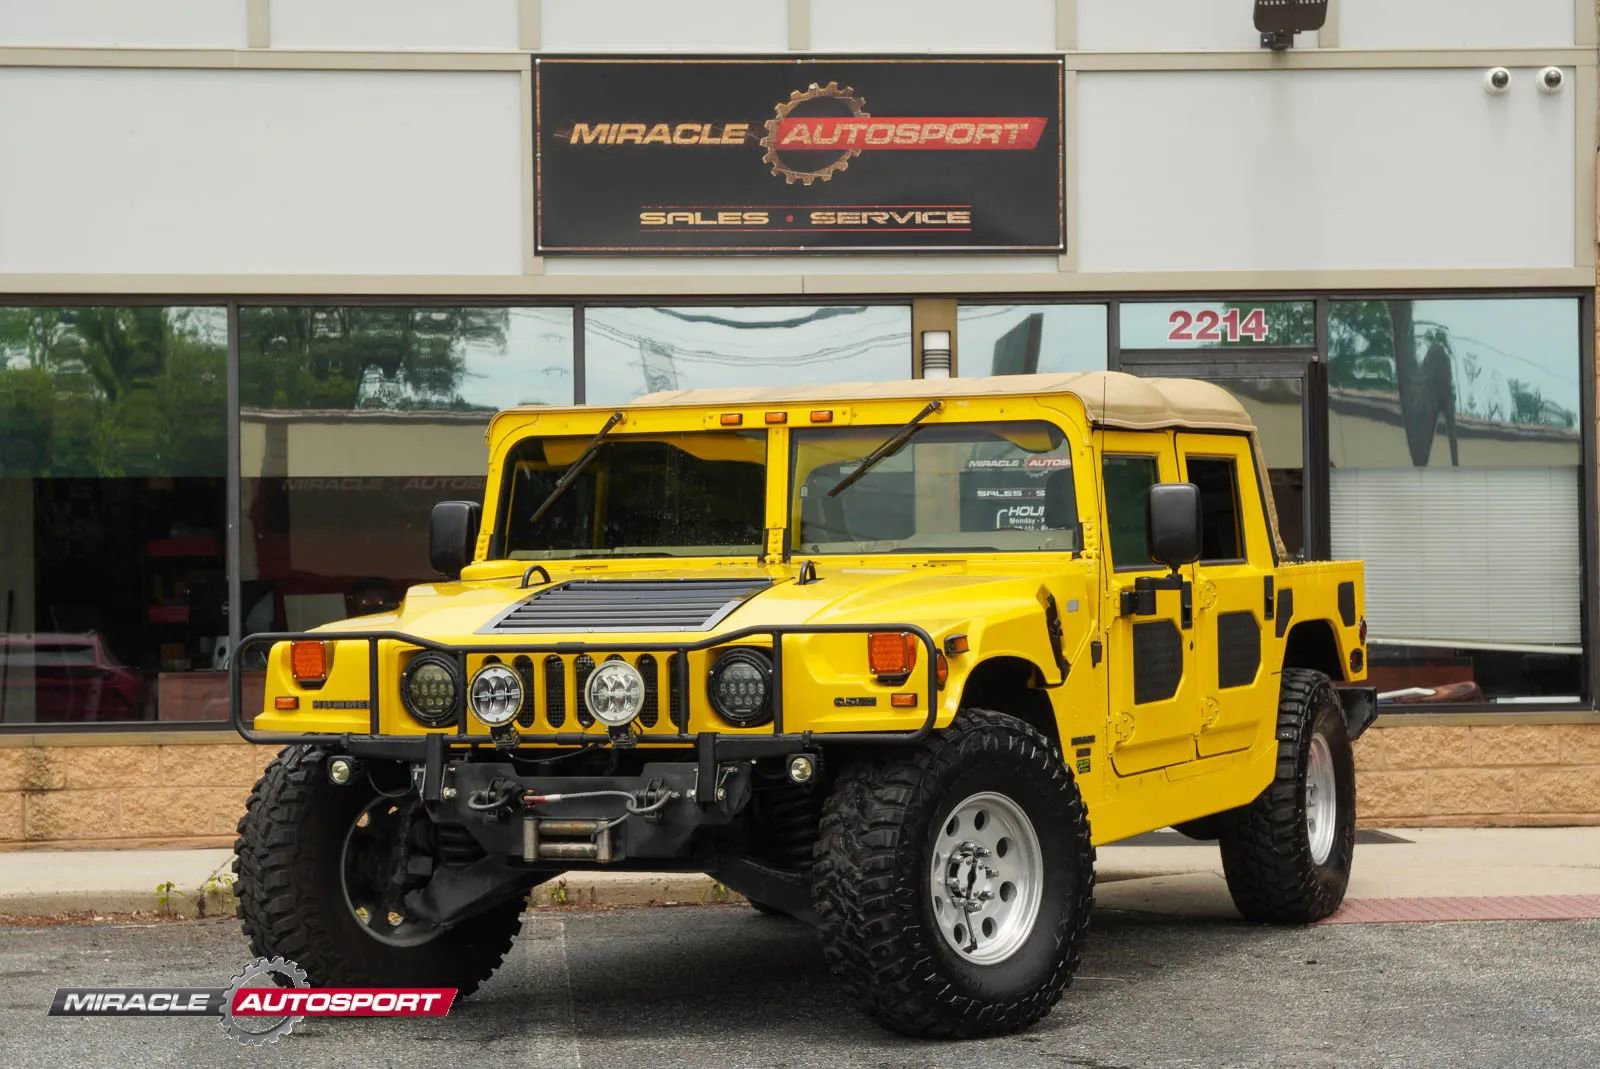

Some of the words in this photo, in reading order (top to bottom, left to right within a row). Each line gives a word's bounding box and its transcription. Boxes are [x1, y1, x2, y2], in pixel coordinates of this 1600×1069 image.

[570, 123, 749, 144] MIRACLE
[782, 122, 1029, 145] AUTOSPORT
[640, 211, 769, 225] SALES
[811, 211, 971, 225] SERVICE
[1168, 308, 1268, 342] 2214
[969, 460, 1019, 468] MIRACLE
[1029, 459, 1071, 467] AUTOS
[282, 479, 383, 491] MIRACLE
[977, 489, 1022, 497] SALES
[1009, 517, 1036, 525] Monday
